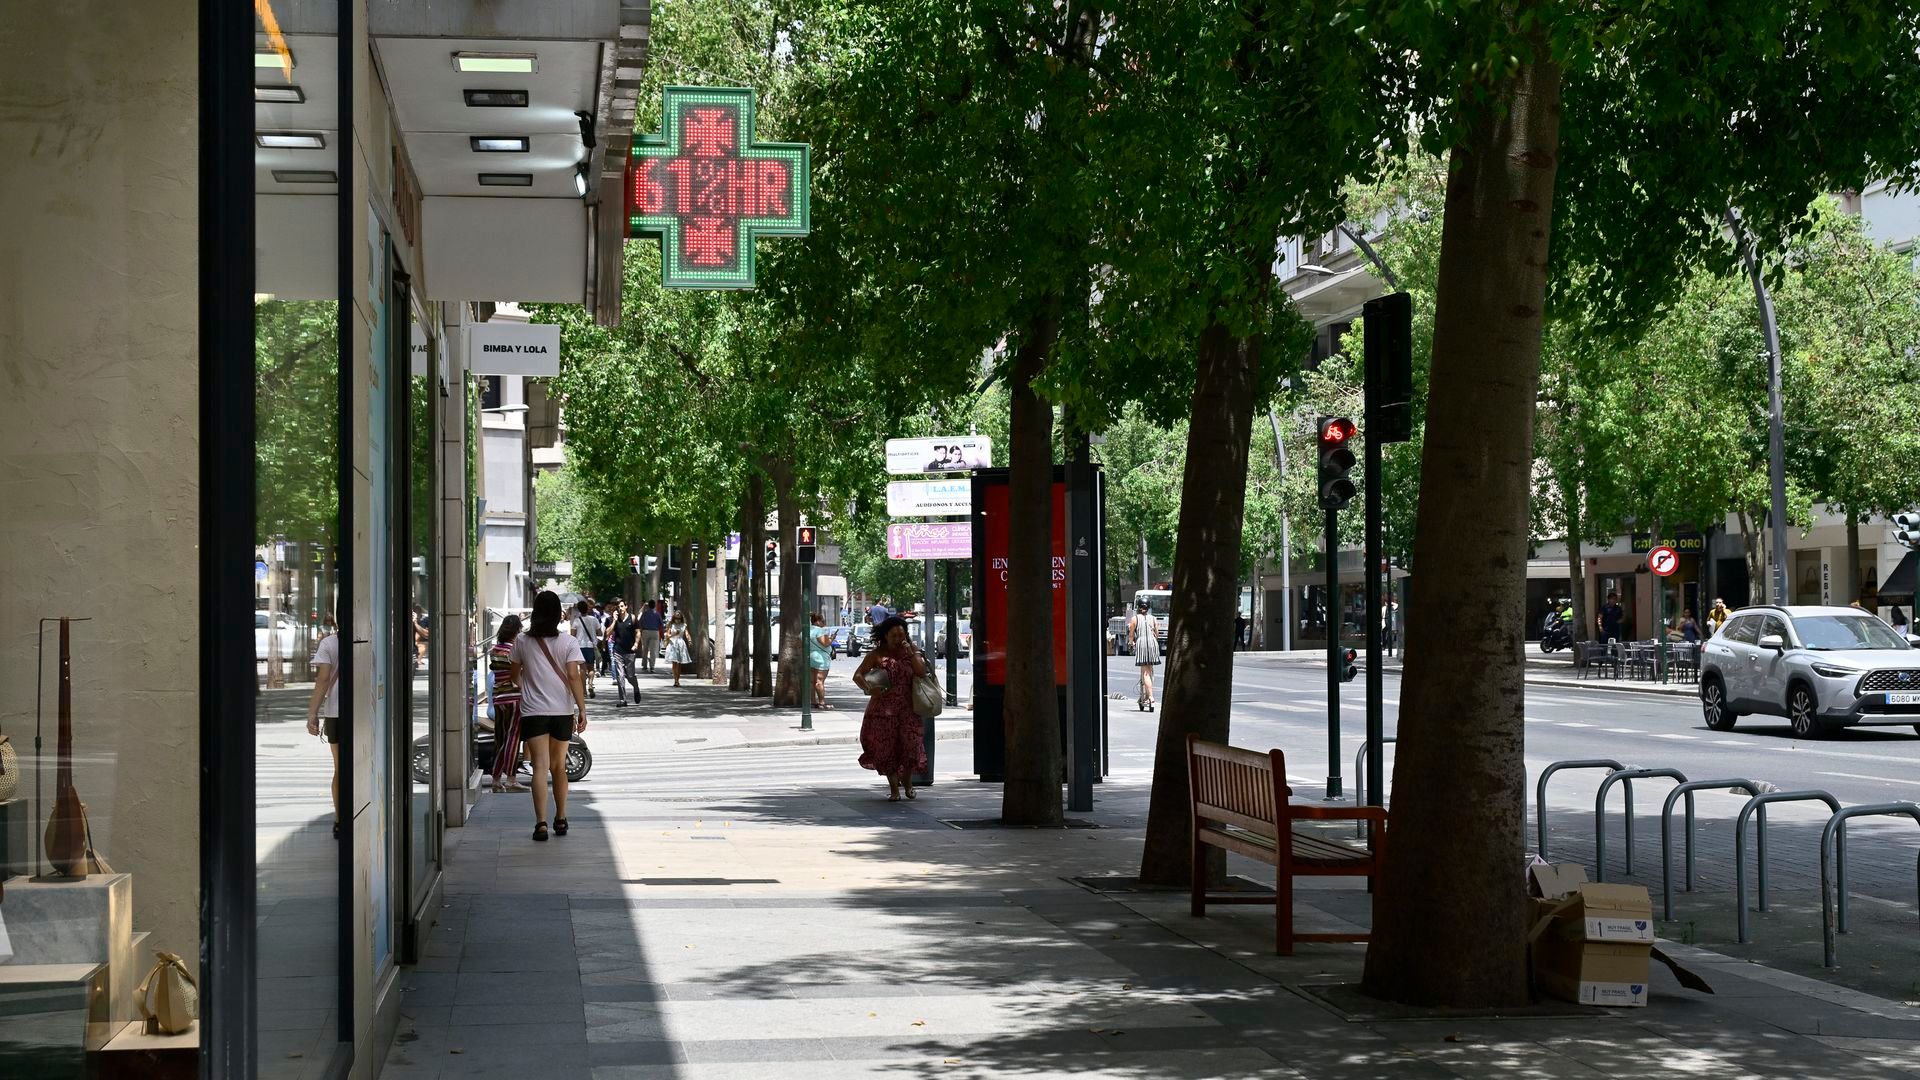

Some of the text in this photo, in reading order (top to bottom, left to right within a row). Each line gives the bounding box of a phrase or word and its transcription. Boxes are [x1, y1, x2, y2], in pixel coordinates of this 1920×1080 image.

[483, 344, 548, 354] BIMBA Y LOLA
[1679, 538, 1701, 549] ORO
[1891, 695, 1911, 703] 6080
